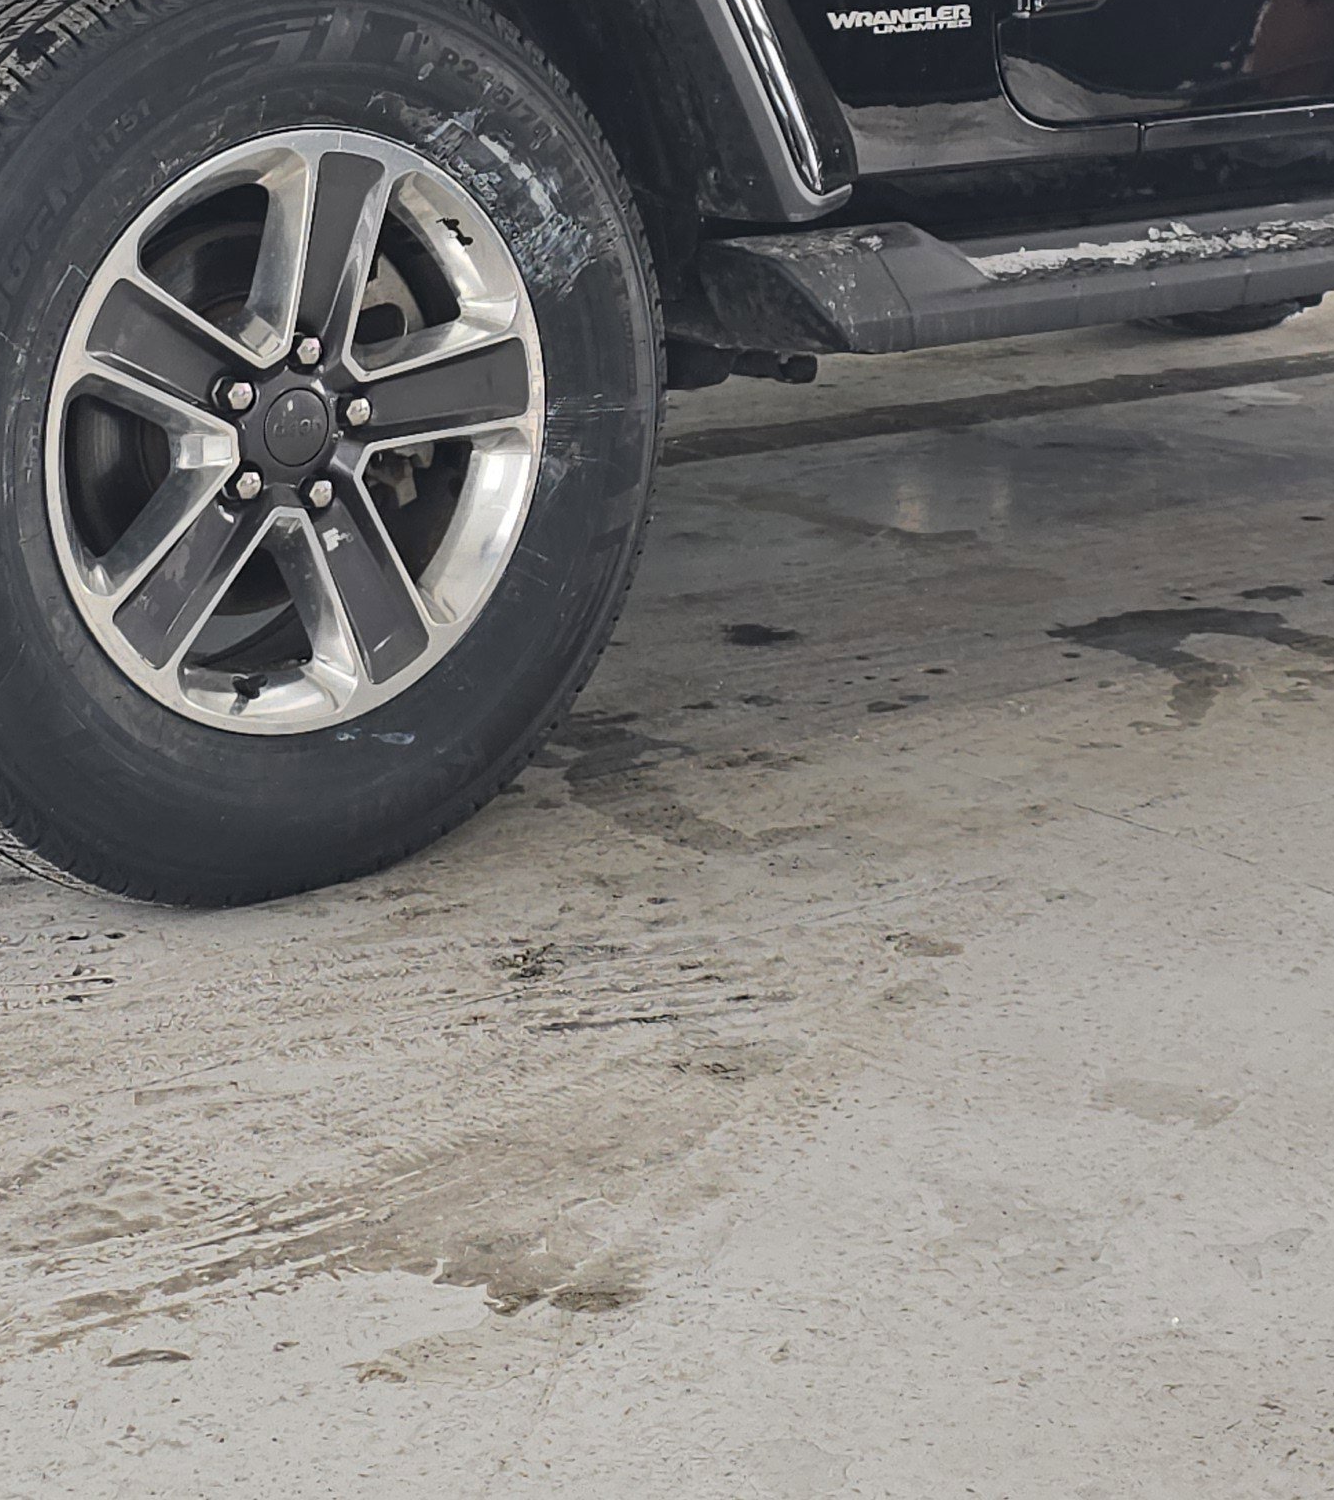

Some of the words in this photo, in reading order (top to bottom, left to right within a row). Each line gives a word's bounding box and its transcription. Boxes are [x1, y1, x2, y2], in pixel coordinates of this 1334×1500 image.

[826, 4, 971, 31] WRANGLER
[873, 19, 972, 35] UNLIMITED
[88, 97, 152, 163] HT51
